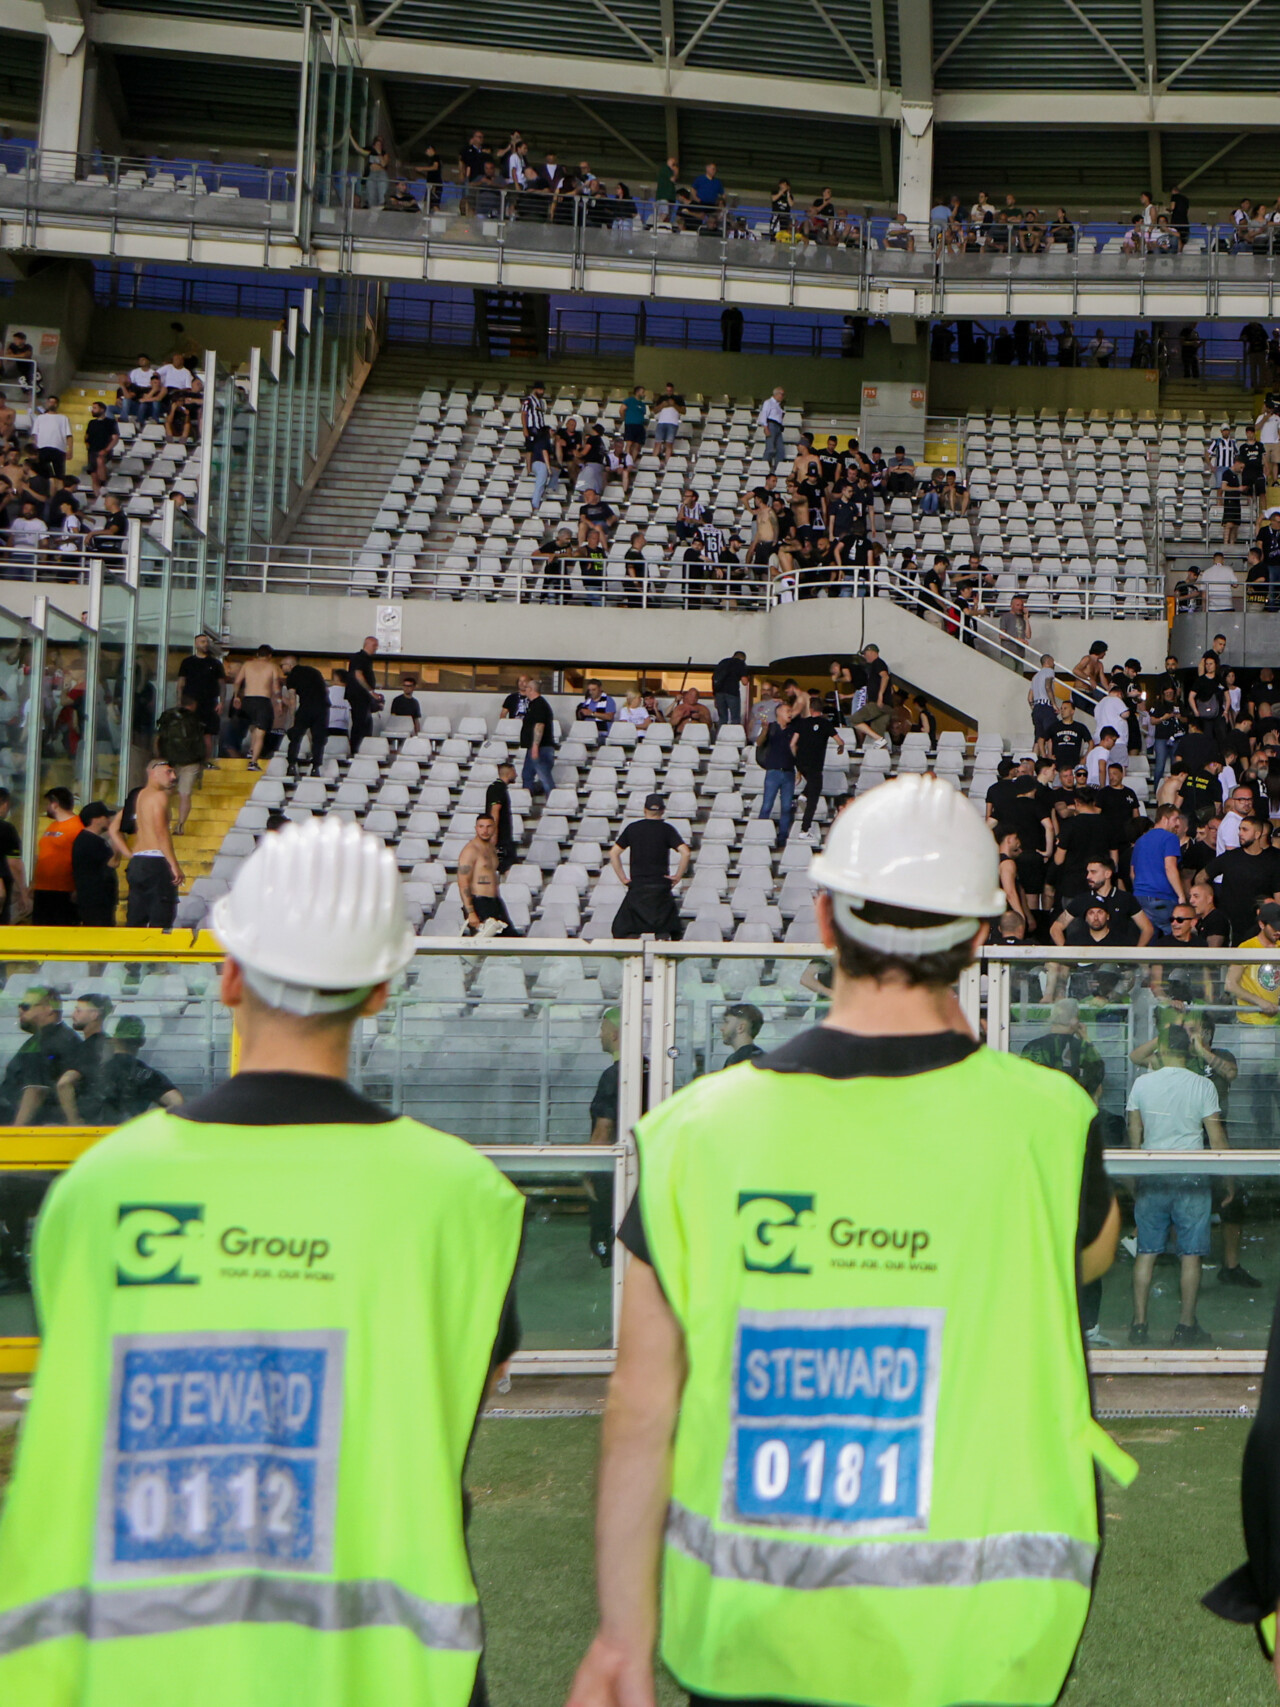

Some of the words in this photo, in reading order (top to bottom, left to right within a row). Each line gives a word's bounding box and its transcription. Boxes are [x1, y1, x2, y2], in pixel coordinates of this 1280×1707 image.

[707, 536, 718, 551] 16
[219, 1226, 331, 1267] Group
[830, 1217, 930, 1259] Group
[127, 1370, 313, 1434] STEWARD
[745, 1346, 919, 1402] STEWARD
[754, 1438, 901, 1508] 0181
[128, 1466, 295, 1541] 0112
